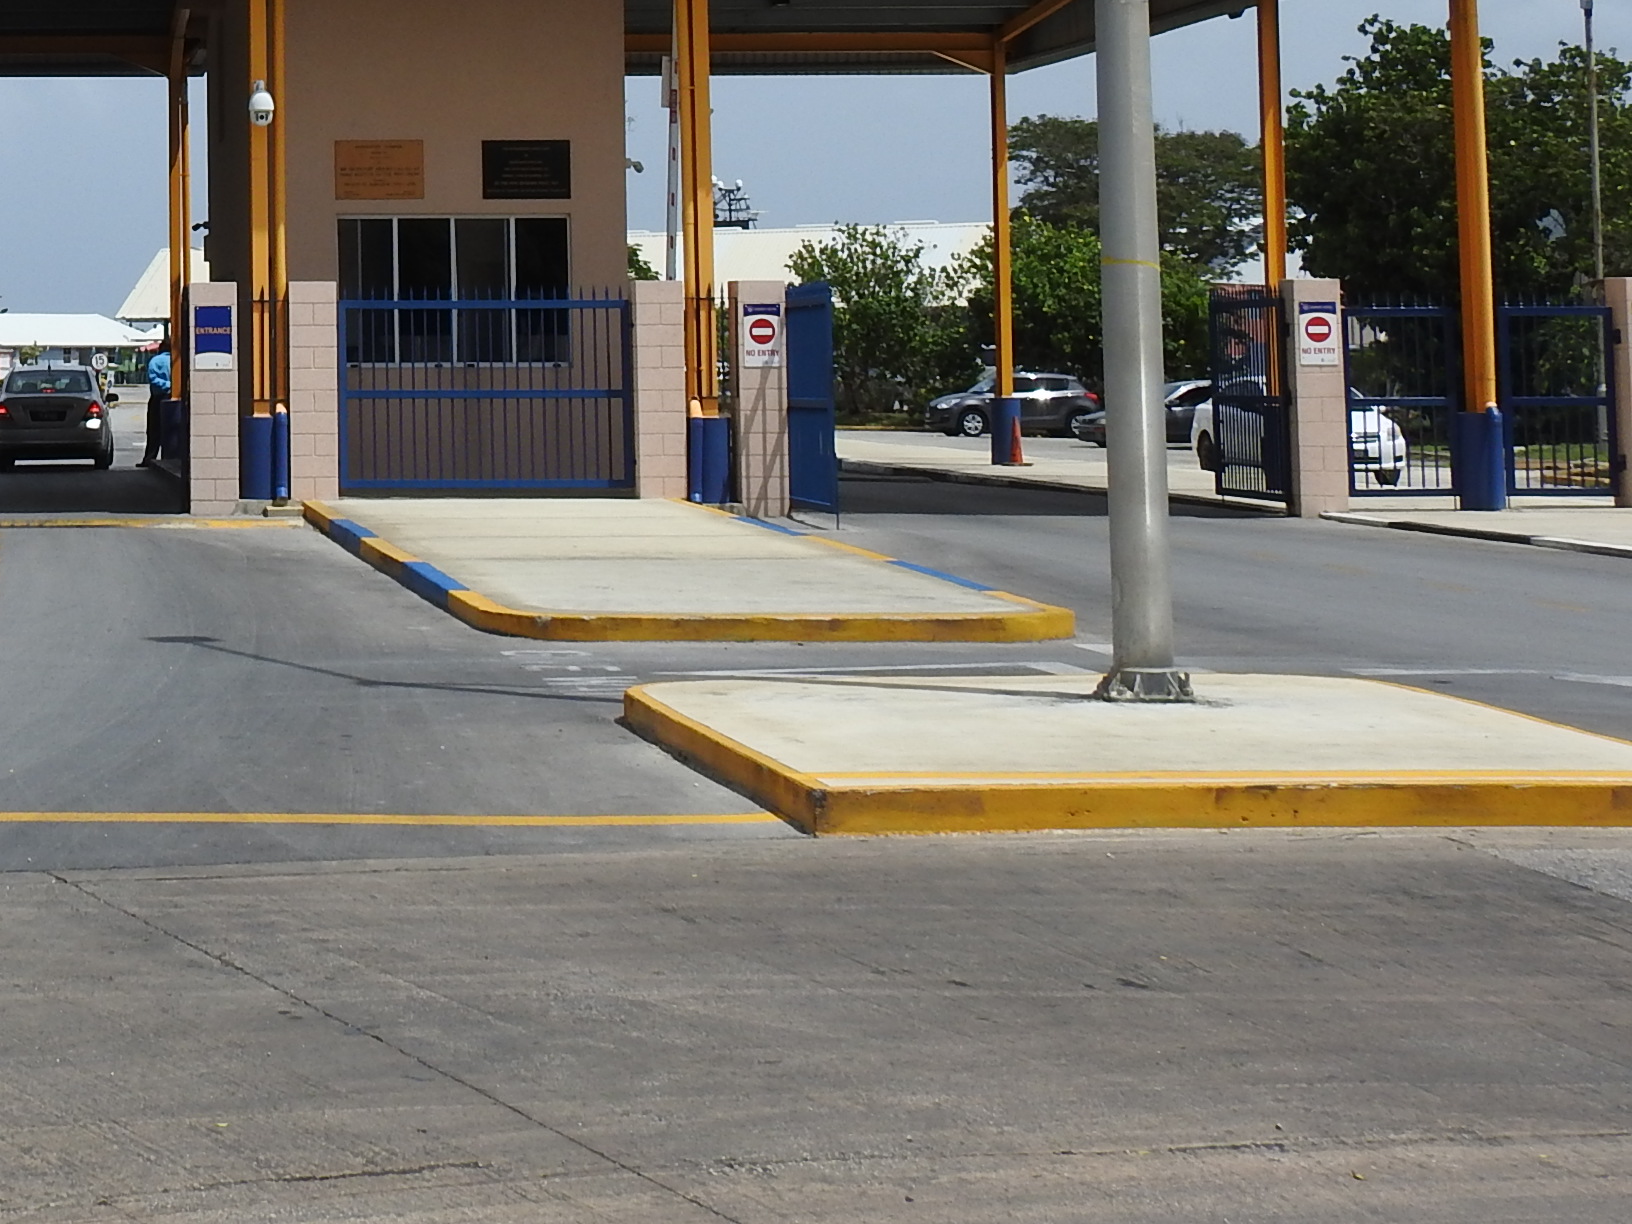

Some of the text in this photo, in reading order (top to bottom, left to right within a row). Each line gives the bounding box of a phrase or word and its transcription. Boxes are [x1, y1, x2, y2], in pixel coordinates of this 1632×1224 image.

[746, 349, 780, 357] NO ENTRY
[1302, 347, 1336, 355] NO ENTRY
[95, 355, 105, 366] 15
